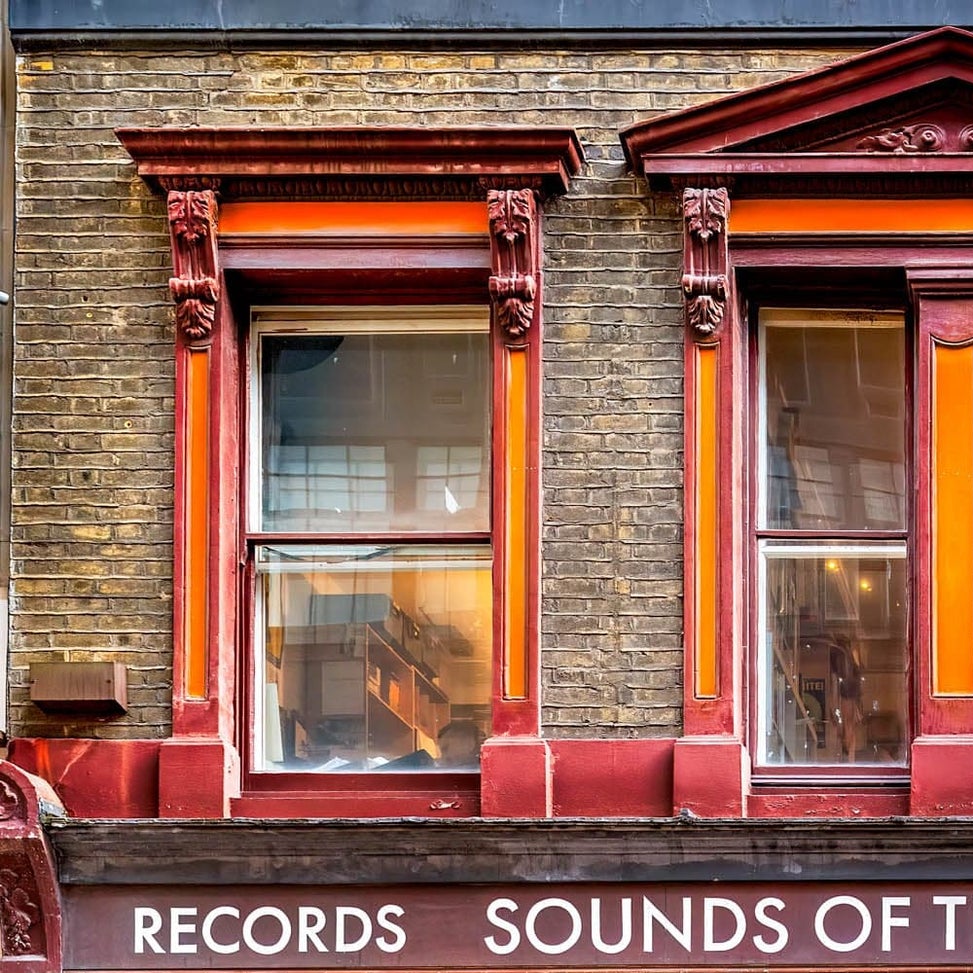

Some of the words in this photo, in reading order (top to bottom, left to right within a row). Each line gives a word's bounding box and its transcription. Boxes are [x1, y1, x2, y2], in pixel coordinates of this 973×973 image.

[132, 904, 406, 955] RECORDS
[483, 895, 789, 955] SOUNDS
[814, 895, 911, 953] OF
